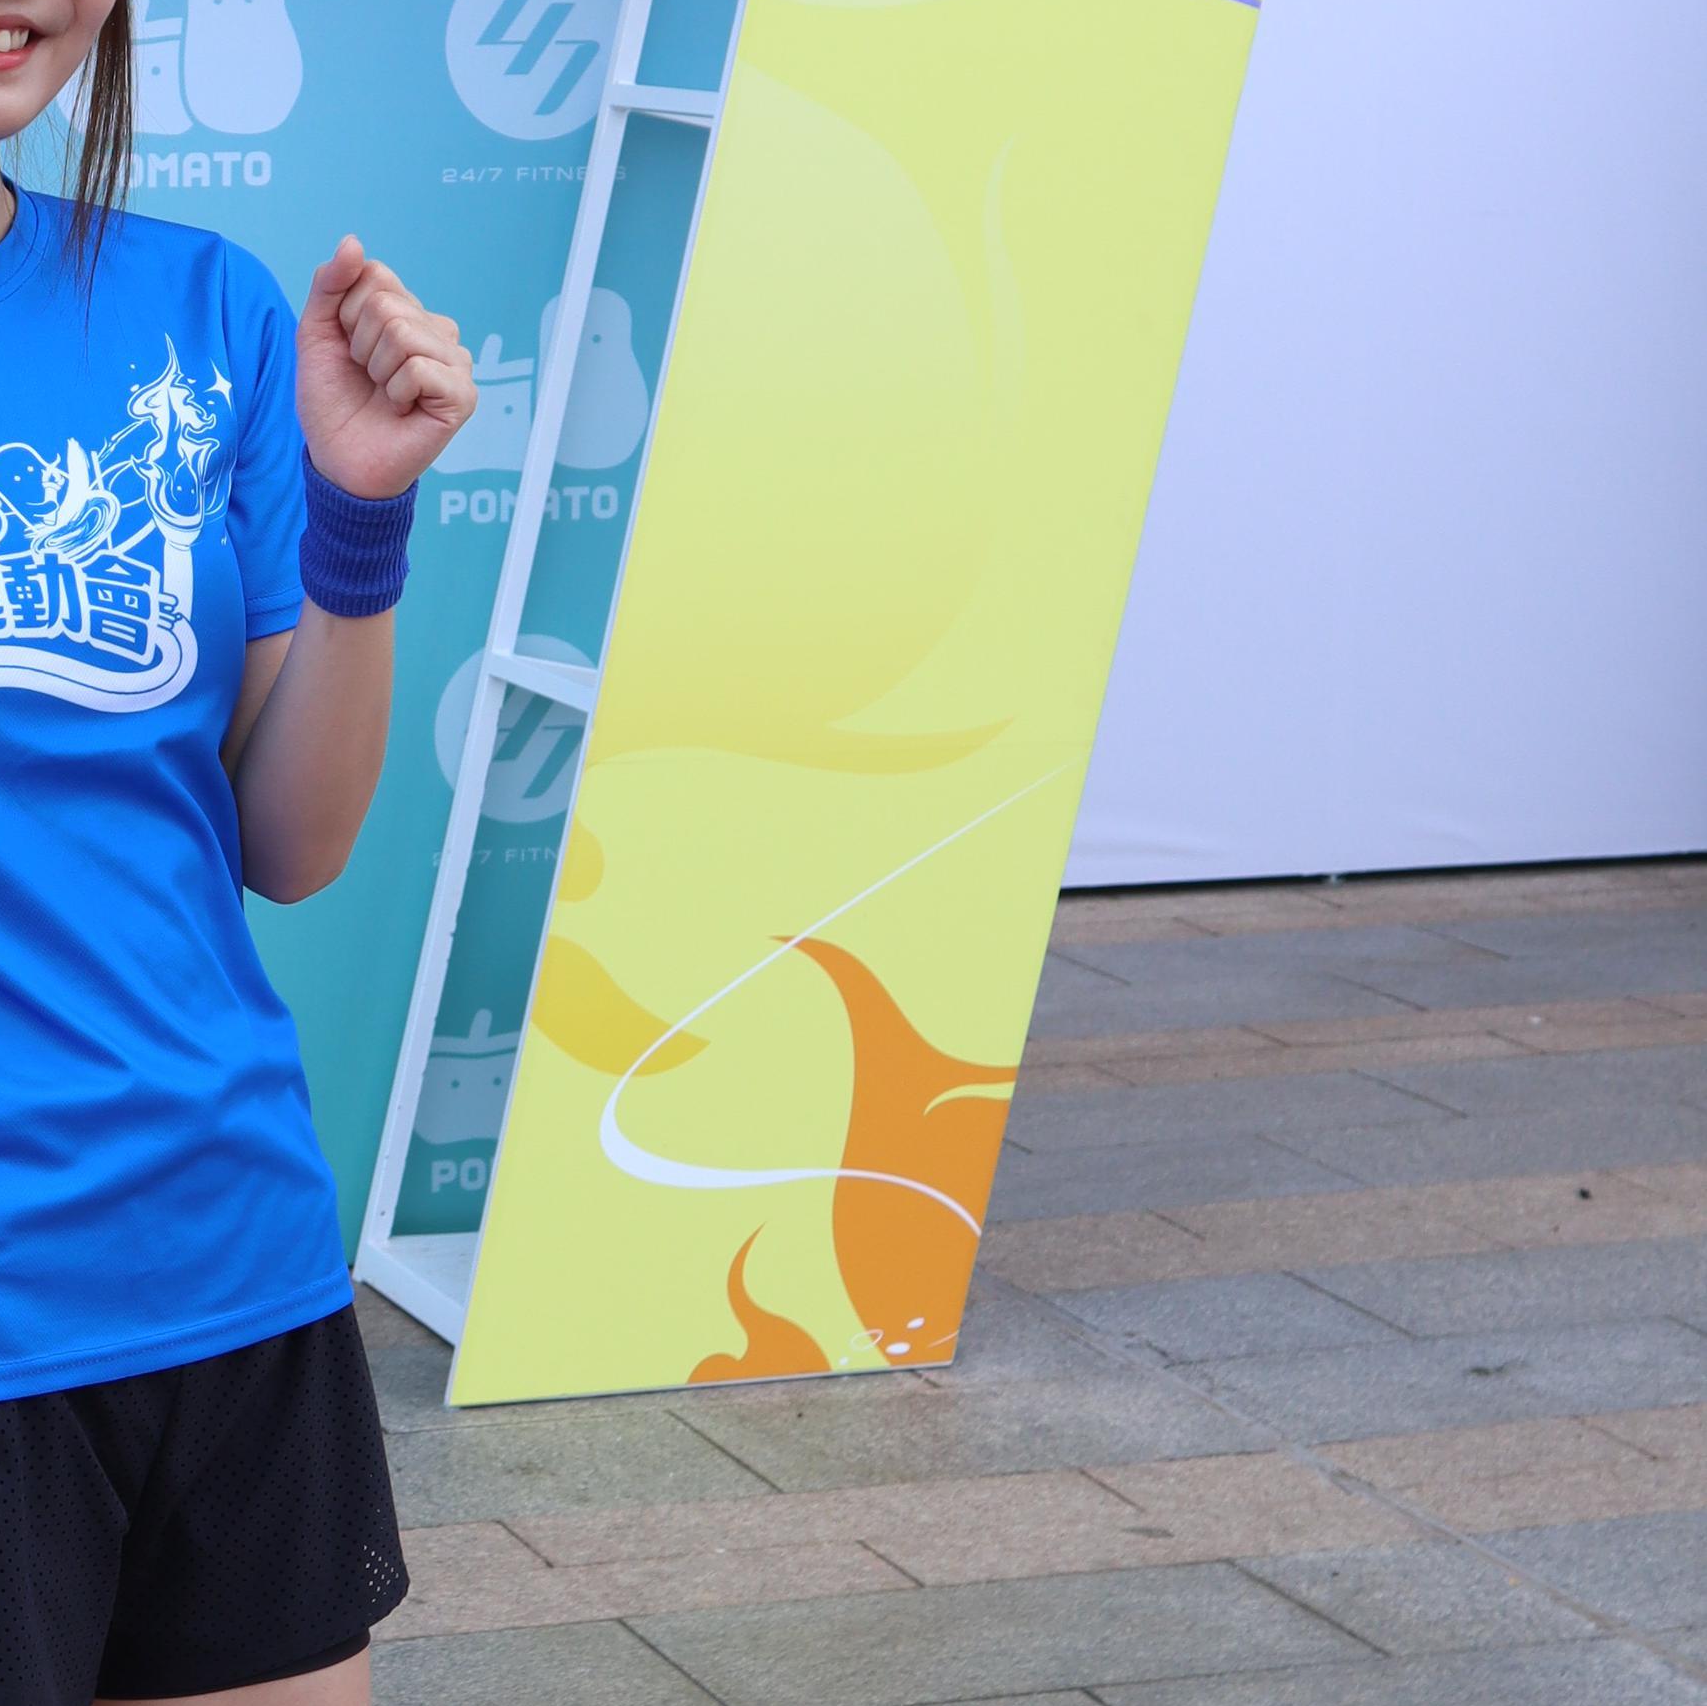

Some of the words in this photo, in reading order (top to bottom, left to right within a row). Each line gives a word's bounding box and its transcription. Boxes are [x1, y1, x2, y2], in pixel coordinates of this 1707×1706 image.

[88, 151, 272, 188] OMATO
[442, 168, 503, 183] 24/7
[516, 166, 626, 181] FITNES
